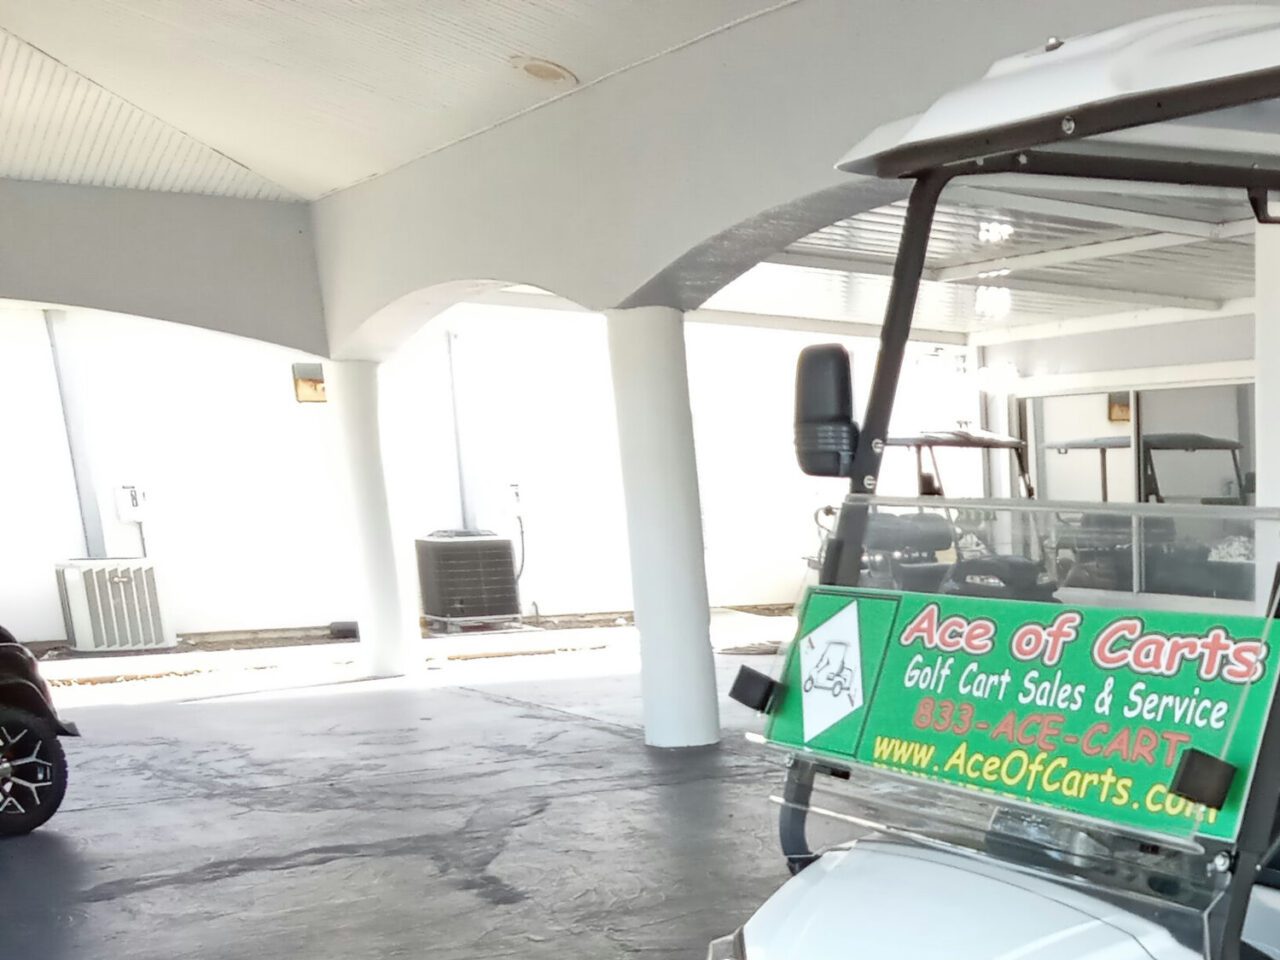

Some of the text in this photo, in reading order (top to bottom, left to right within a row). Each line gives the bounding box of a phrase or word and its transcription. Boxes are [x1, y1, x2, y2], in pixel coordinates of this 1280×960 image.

[900, 602, 1269, 684] Ace of Carts
[904, 654, 1228, 729] Golf Cart Sales & Service
[914, 696, 1191, 767] 833-ACE-CART
